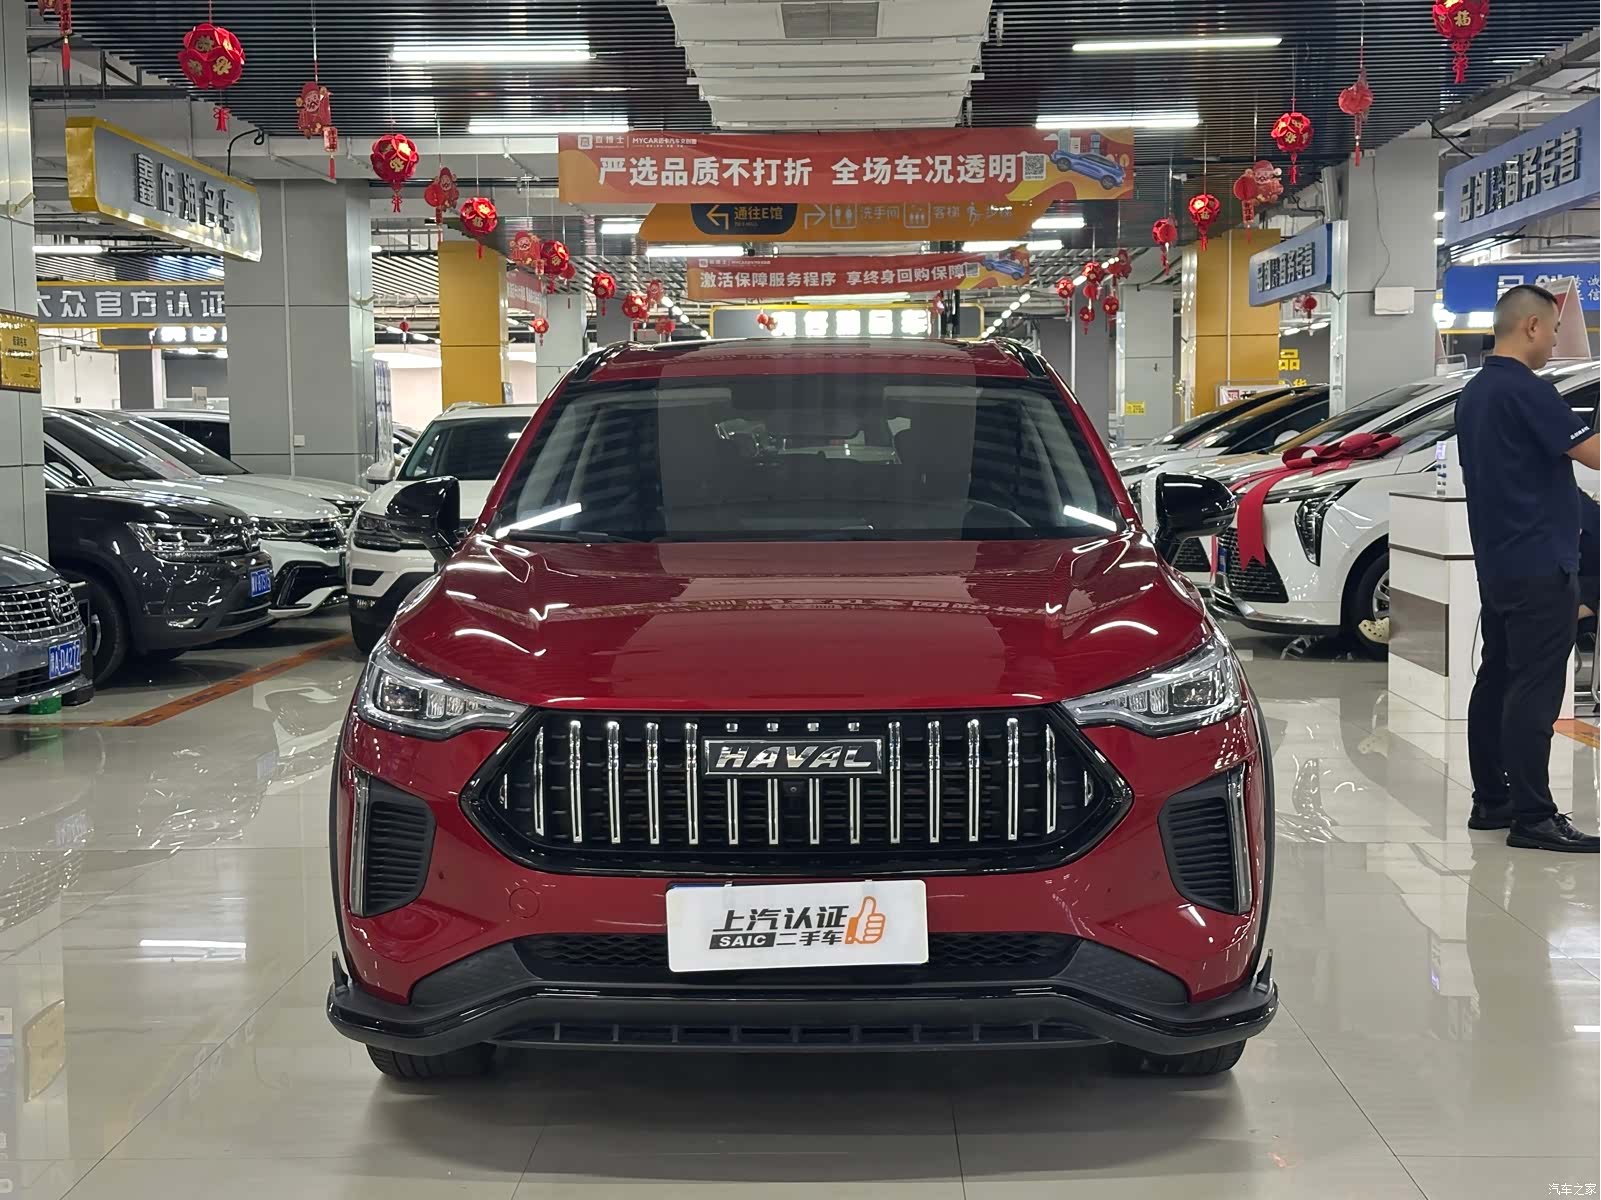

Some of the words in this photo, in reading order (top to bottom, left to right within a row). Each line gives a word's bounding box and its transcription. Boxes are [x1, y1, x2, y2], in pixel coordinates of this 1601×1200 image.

[598, 156, 813, 186] 严选品质不打折
[831, 154, 1016, 185] 全场车况透明
[733, 206, 783, 221] 通往E馆
[862, 206, 899, 219] 洗手间
[933, 206, 960, 219] 客梯
[700, 271, 837, 288] 激活保障服务程序
[846, 264, 965, 285] 享终身回购保障
[37, 290, 226, 317] 大众官方认证
[715, 745, 871, 769] HAVAL
[712, 905, 849, 932] 上汽认证
[719, 935, 767, 947] SAIC
[776, 930, 843, 946] 二手车
